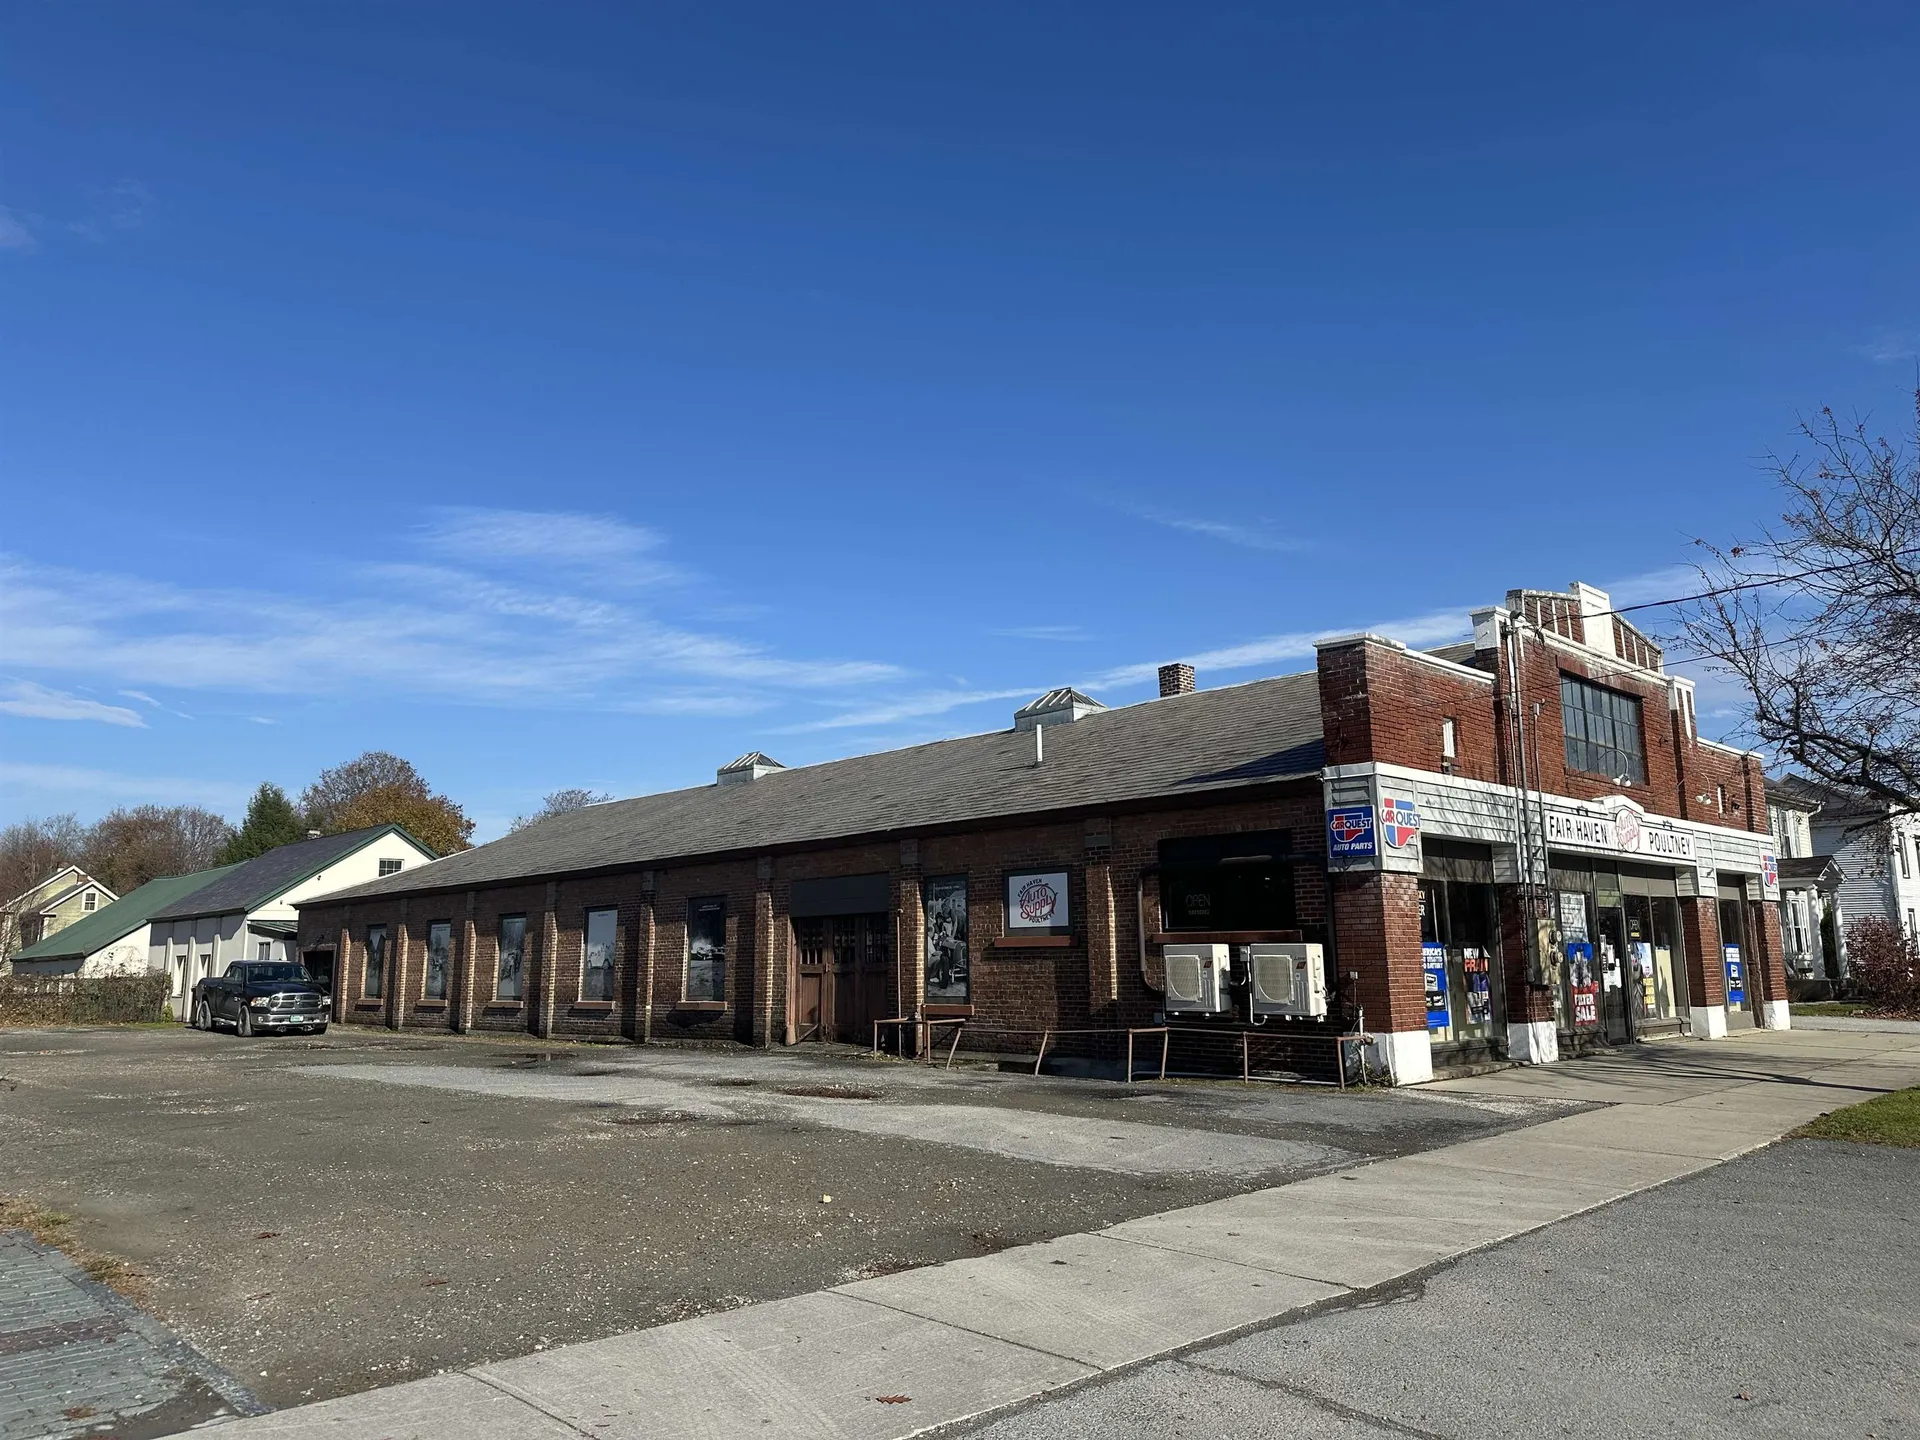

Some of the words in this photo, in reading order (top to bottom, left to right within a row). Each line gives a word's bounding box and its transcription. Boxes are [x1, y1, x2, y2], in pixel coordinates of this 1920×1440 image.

[1381, 808, 1421, 827] CARQUEST
[1330, 818, 1372, 831] CARQUEST
[1549, 815, 1573, 839] FAIR
[1576, 819, 1608, 845] HAVEN
[1333, 843, 1349, 851] AUTO
[1351, 842, 1372, 850] PARTS
[1648, 831, 1691, 856] POULTNEY
[1025, 878, 1042, 888] HAVEN
[1185, 893, 1211, 907] OPEN
[1028, 912, 1053, 924] POULTNEY
[1422, 947, 1442, 956] ERICA'S
[1463, 947, 1479, 959] NEW
[1574, 993, 1594, 1006] FILTER
[1575, 1005, 1596, 1022] SALE
